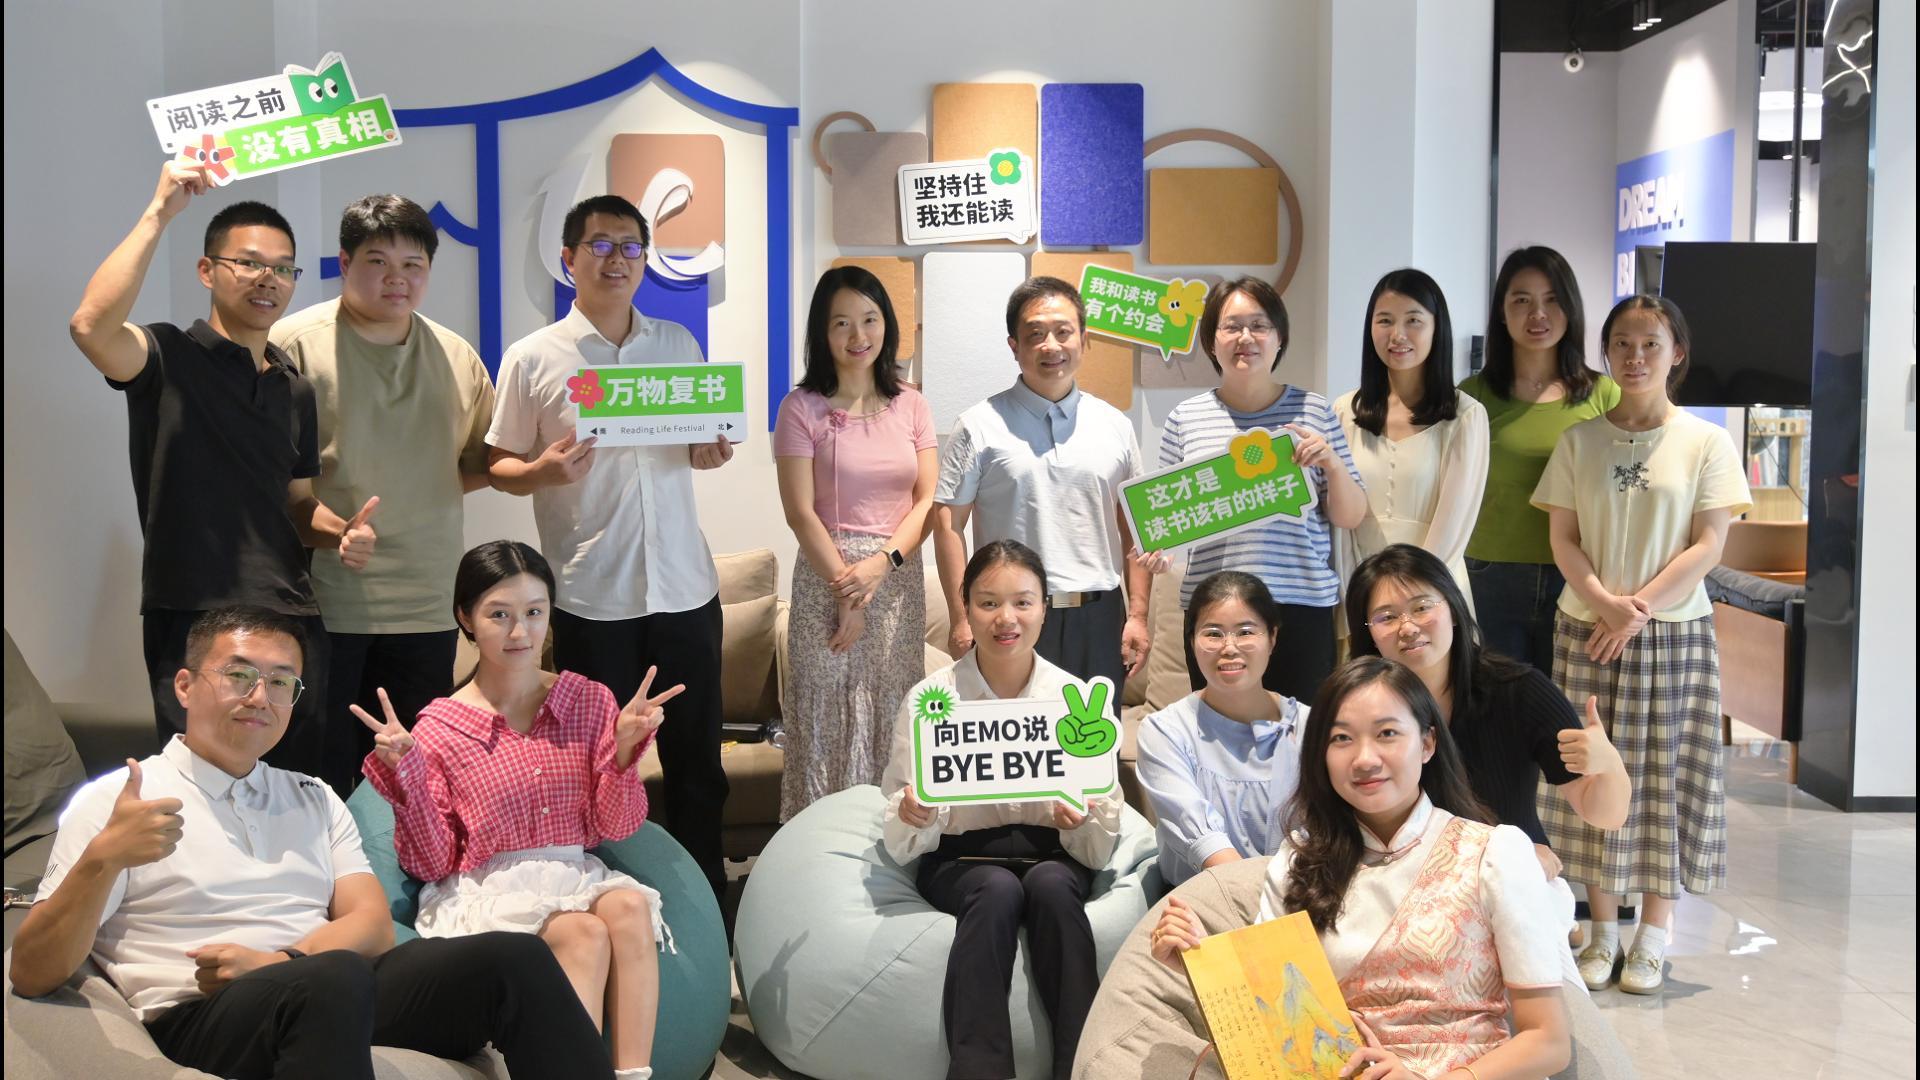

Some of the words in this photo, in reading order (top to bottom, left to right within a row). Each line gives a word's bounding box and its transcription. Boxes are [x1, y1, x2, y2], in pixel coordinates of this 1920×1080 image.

[167, 88, 286, 134] 阅读之前
[241, 109, 383, 164] 没有真相
[914, 172, 987, 200] 坚持住
[916, 198, 1014, 229] 我还能读
[1089, 276, 1158, 307] 我和读书
[1085, 297, 1165, 335] 有个约会
[606, 374, 727, 407] 万物复书
[620, 426, 654, 435] Reading
[656, 425, 672, 433] Life
[673, 424, 705, 433] Festival
[1145, 467, 1222, 509] 这才是
[1144, 473, 1299, 542] 读书该有的样子
[934, 715, 1049, 747] 向EMO说
[932, 752, 995, 784] BYE
[1003, 749, 1066, 780] BYE
